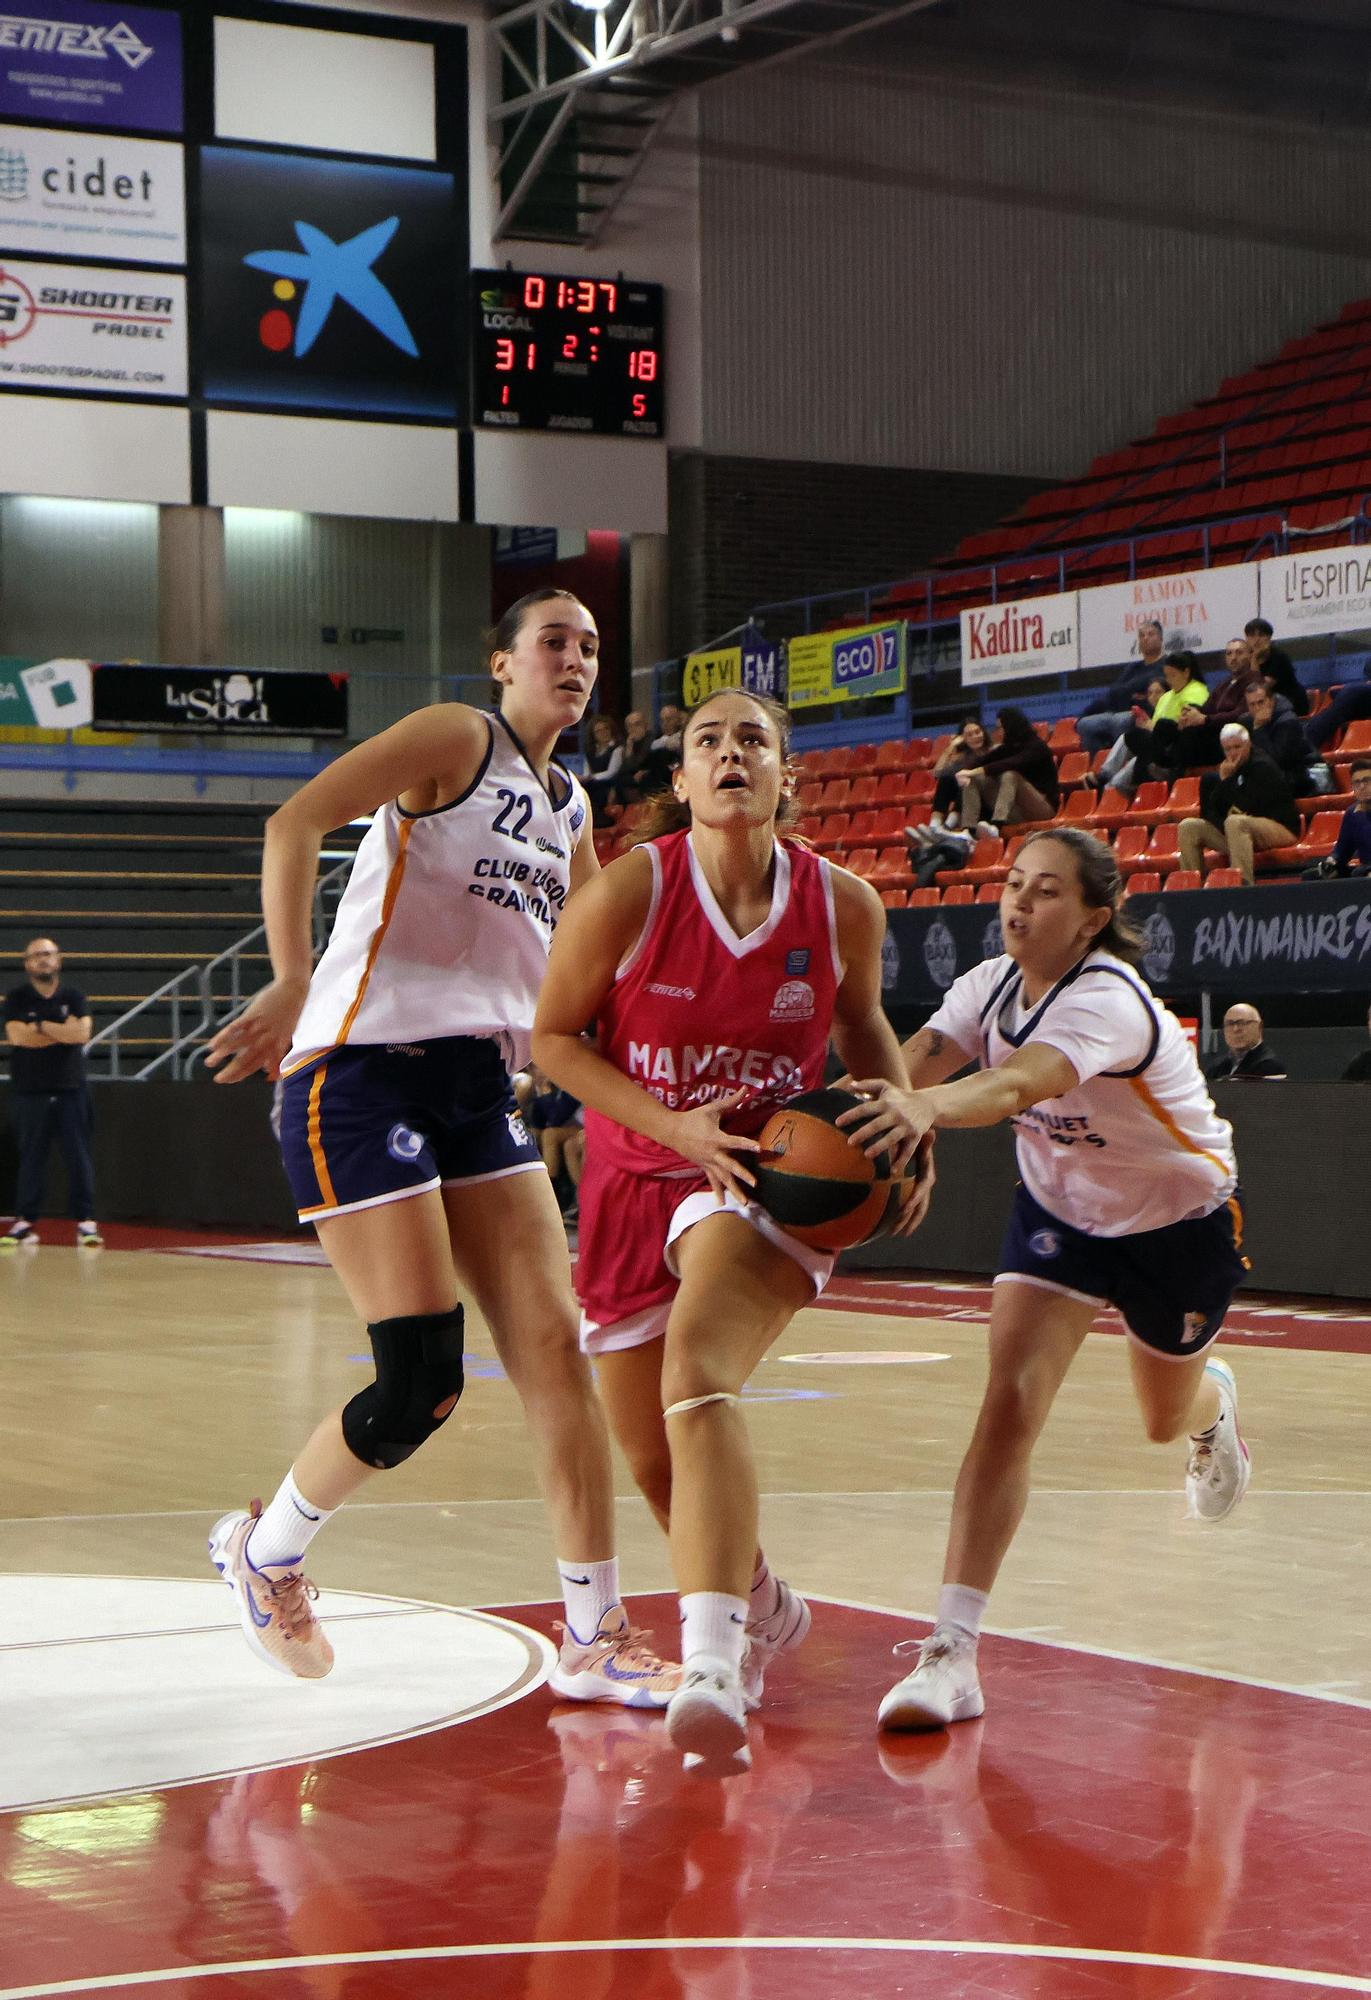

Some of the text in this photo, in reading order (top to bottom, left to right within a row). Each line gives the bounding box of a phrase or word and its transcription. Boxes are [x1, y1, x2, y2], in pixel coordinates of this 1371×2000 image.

[42, 157, 152, 200] cidet
[39, 286, 174, 313] SHOOTER
[525, 276, 617, 313] 01:37
[495, 338, 537, 371] 31
[562, 334, 579, 358] 2
[628, 350, 657, 381] 18
[632, 393, 647, 418] 5
[492, 788, 533, 844] 22
[474, 858, 530, 882] CLUB
